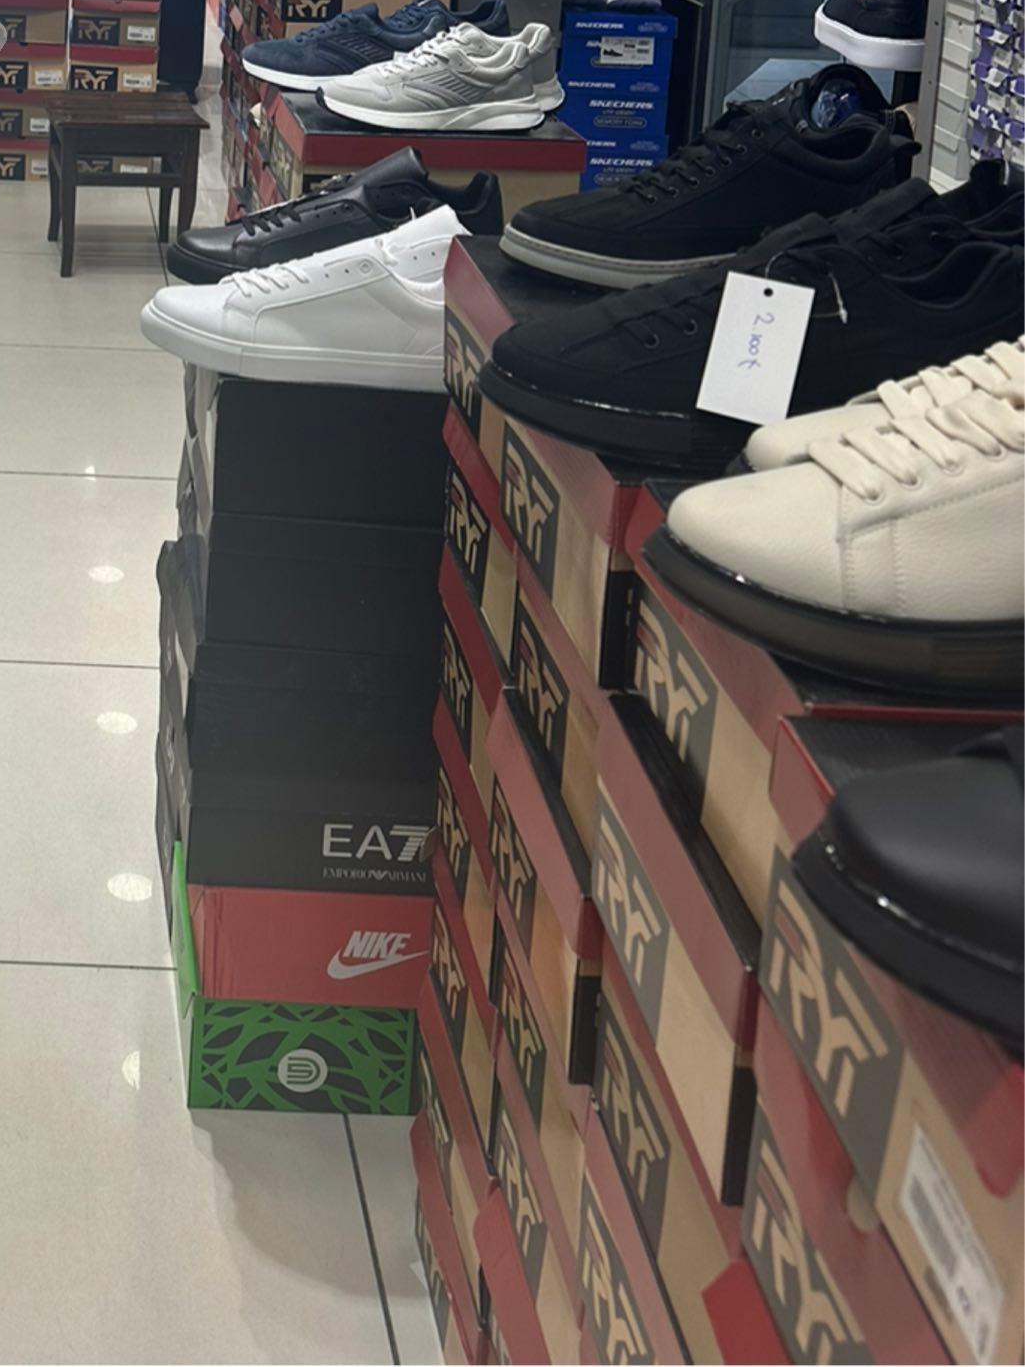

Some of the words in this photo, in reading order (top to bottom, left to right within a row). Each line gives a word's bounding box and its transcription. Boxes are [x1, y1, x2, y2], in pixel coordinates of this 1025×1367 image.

[575, 21, 624, 30] SKECHERS
[567, 81, 616, 89] SKECHERS
[589, 99, 654, 109] SKECHERS
[589, 157, 654, 167] SKECHERS
[344, 931, 412, 959] NIKE
